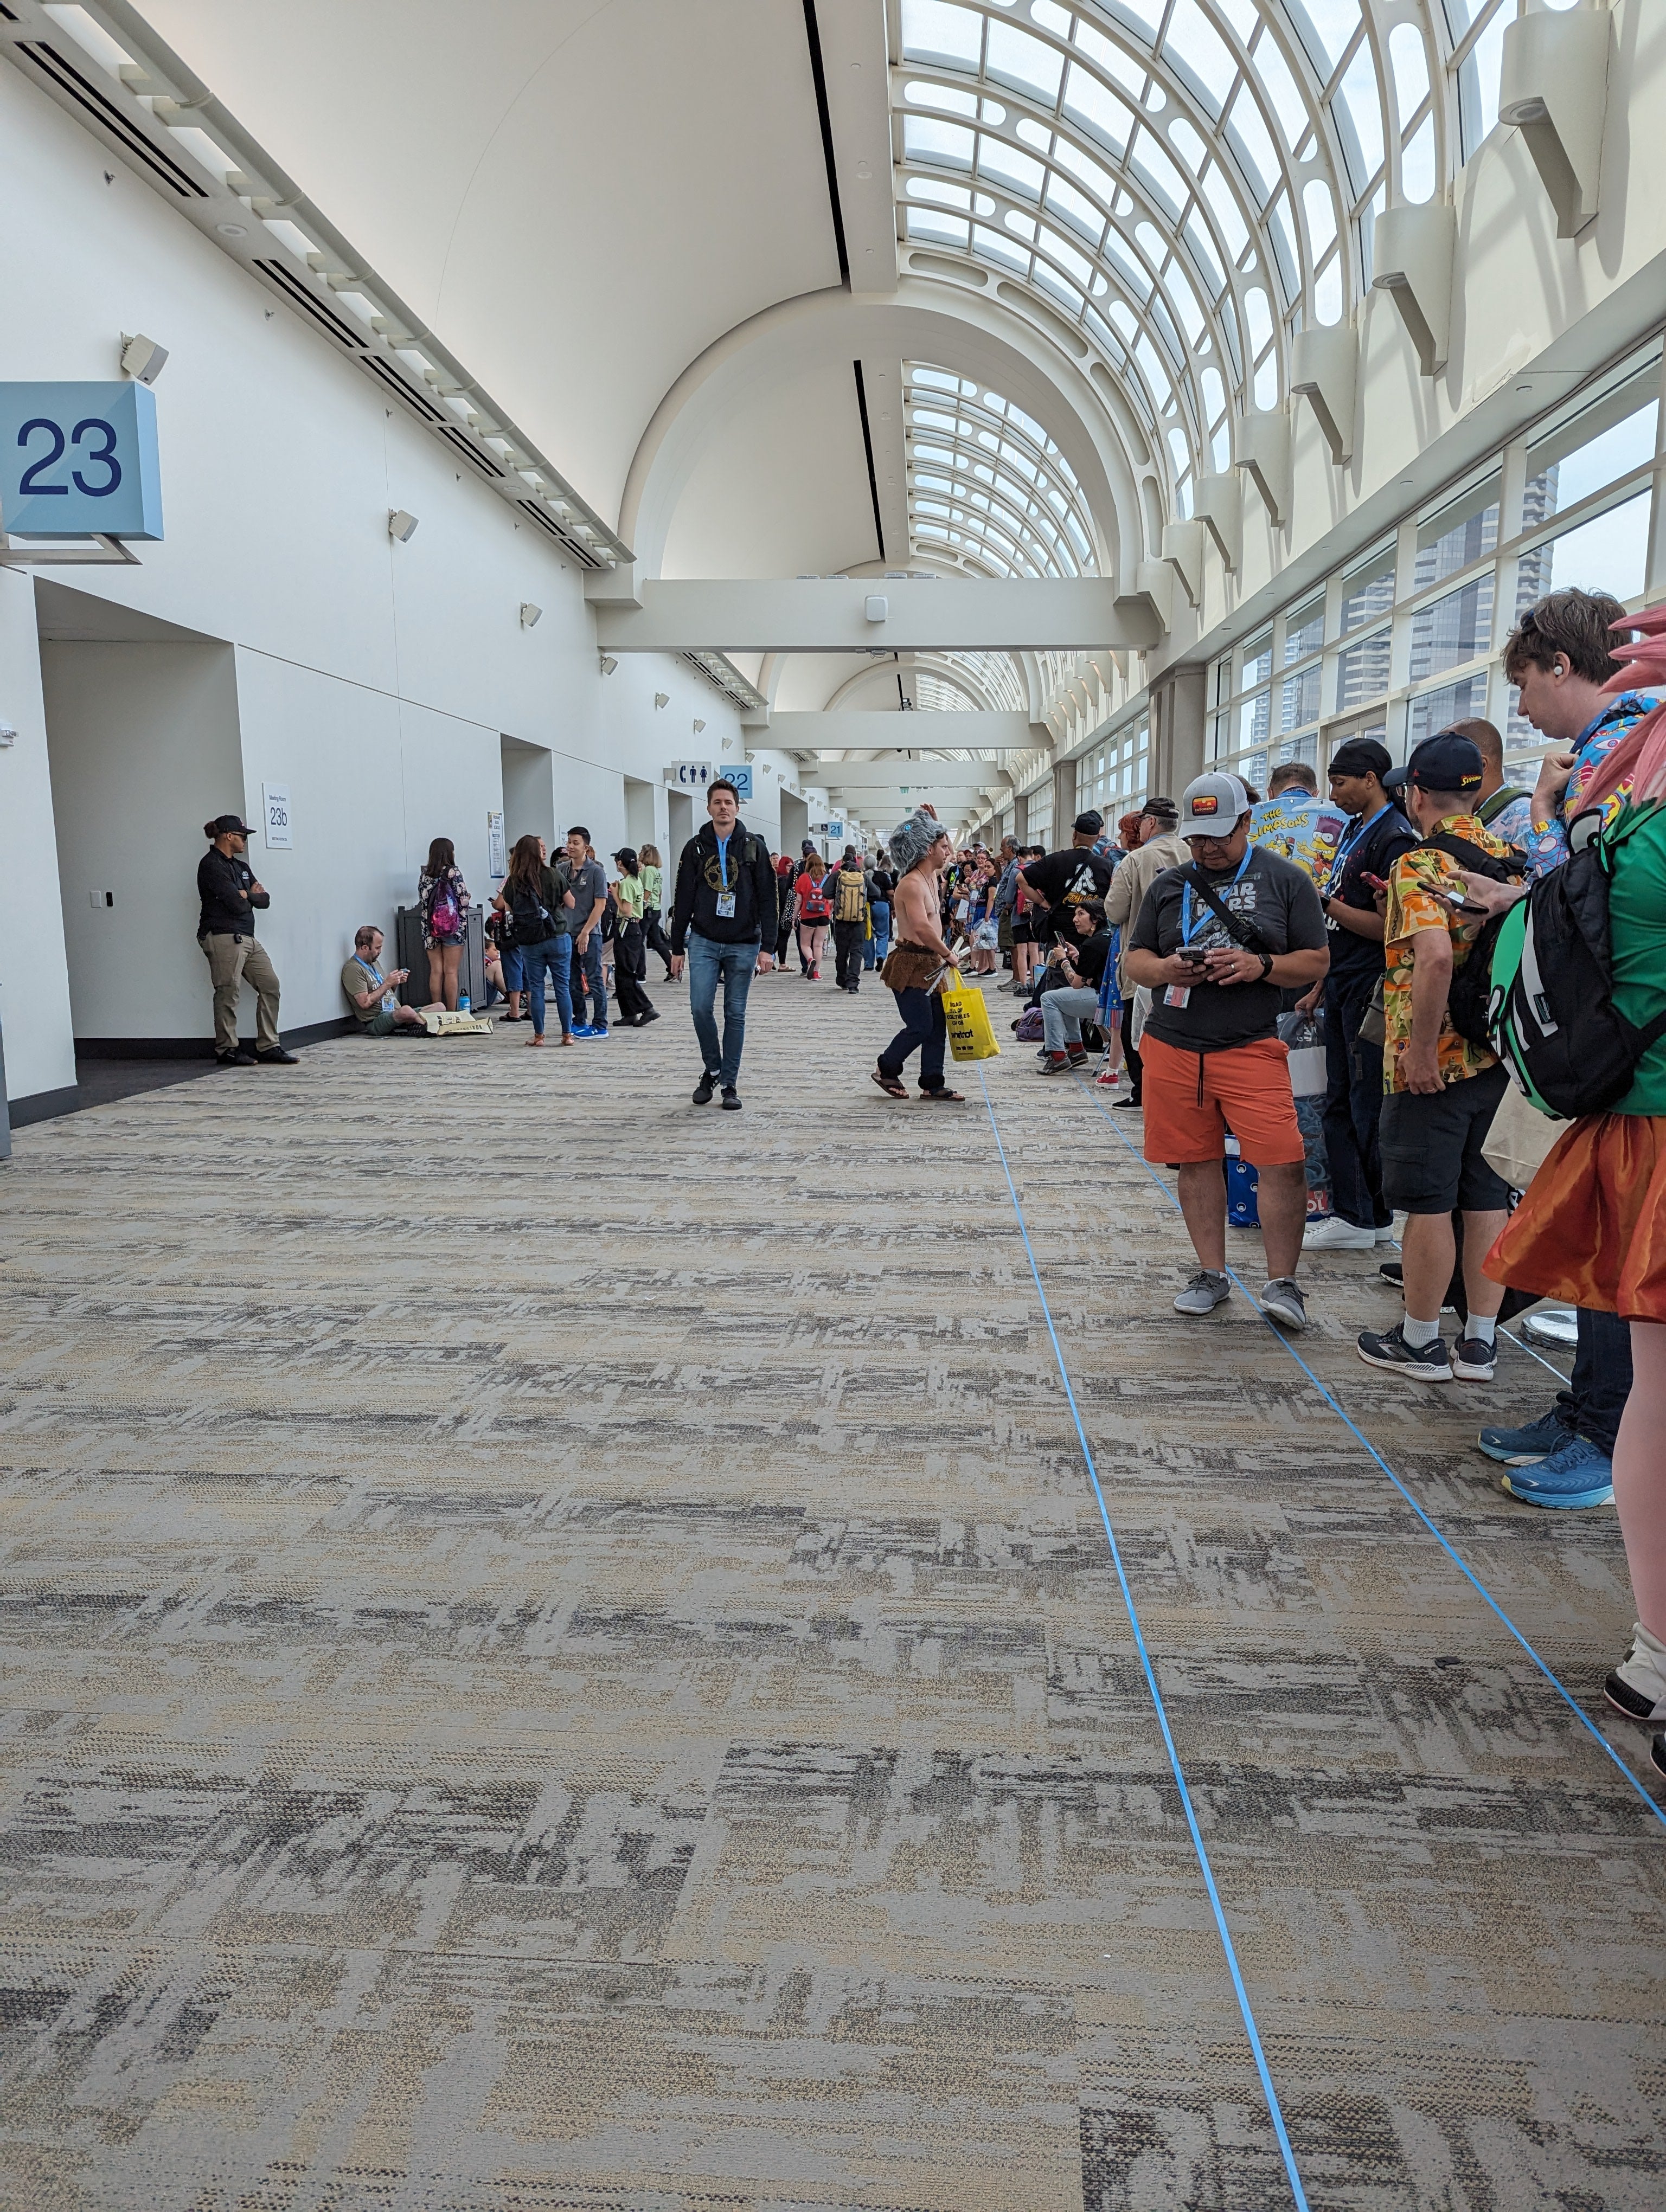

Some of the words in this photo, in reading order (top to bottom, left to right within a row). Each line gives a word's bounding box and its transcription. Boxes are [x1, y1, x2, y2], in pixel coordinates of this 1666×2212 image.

[17, 418, 122, 497] 23
[271, 807, 287, 826] 23b
[830, 825, 840, 834] 21
[1197, 896, 1257, 916] WRS
